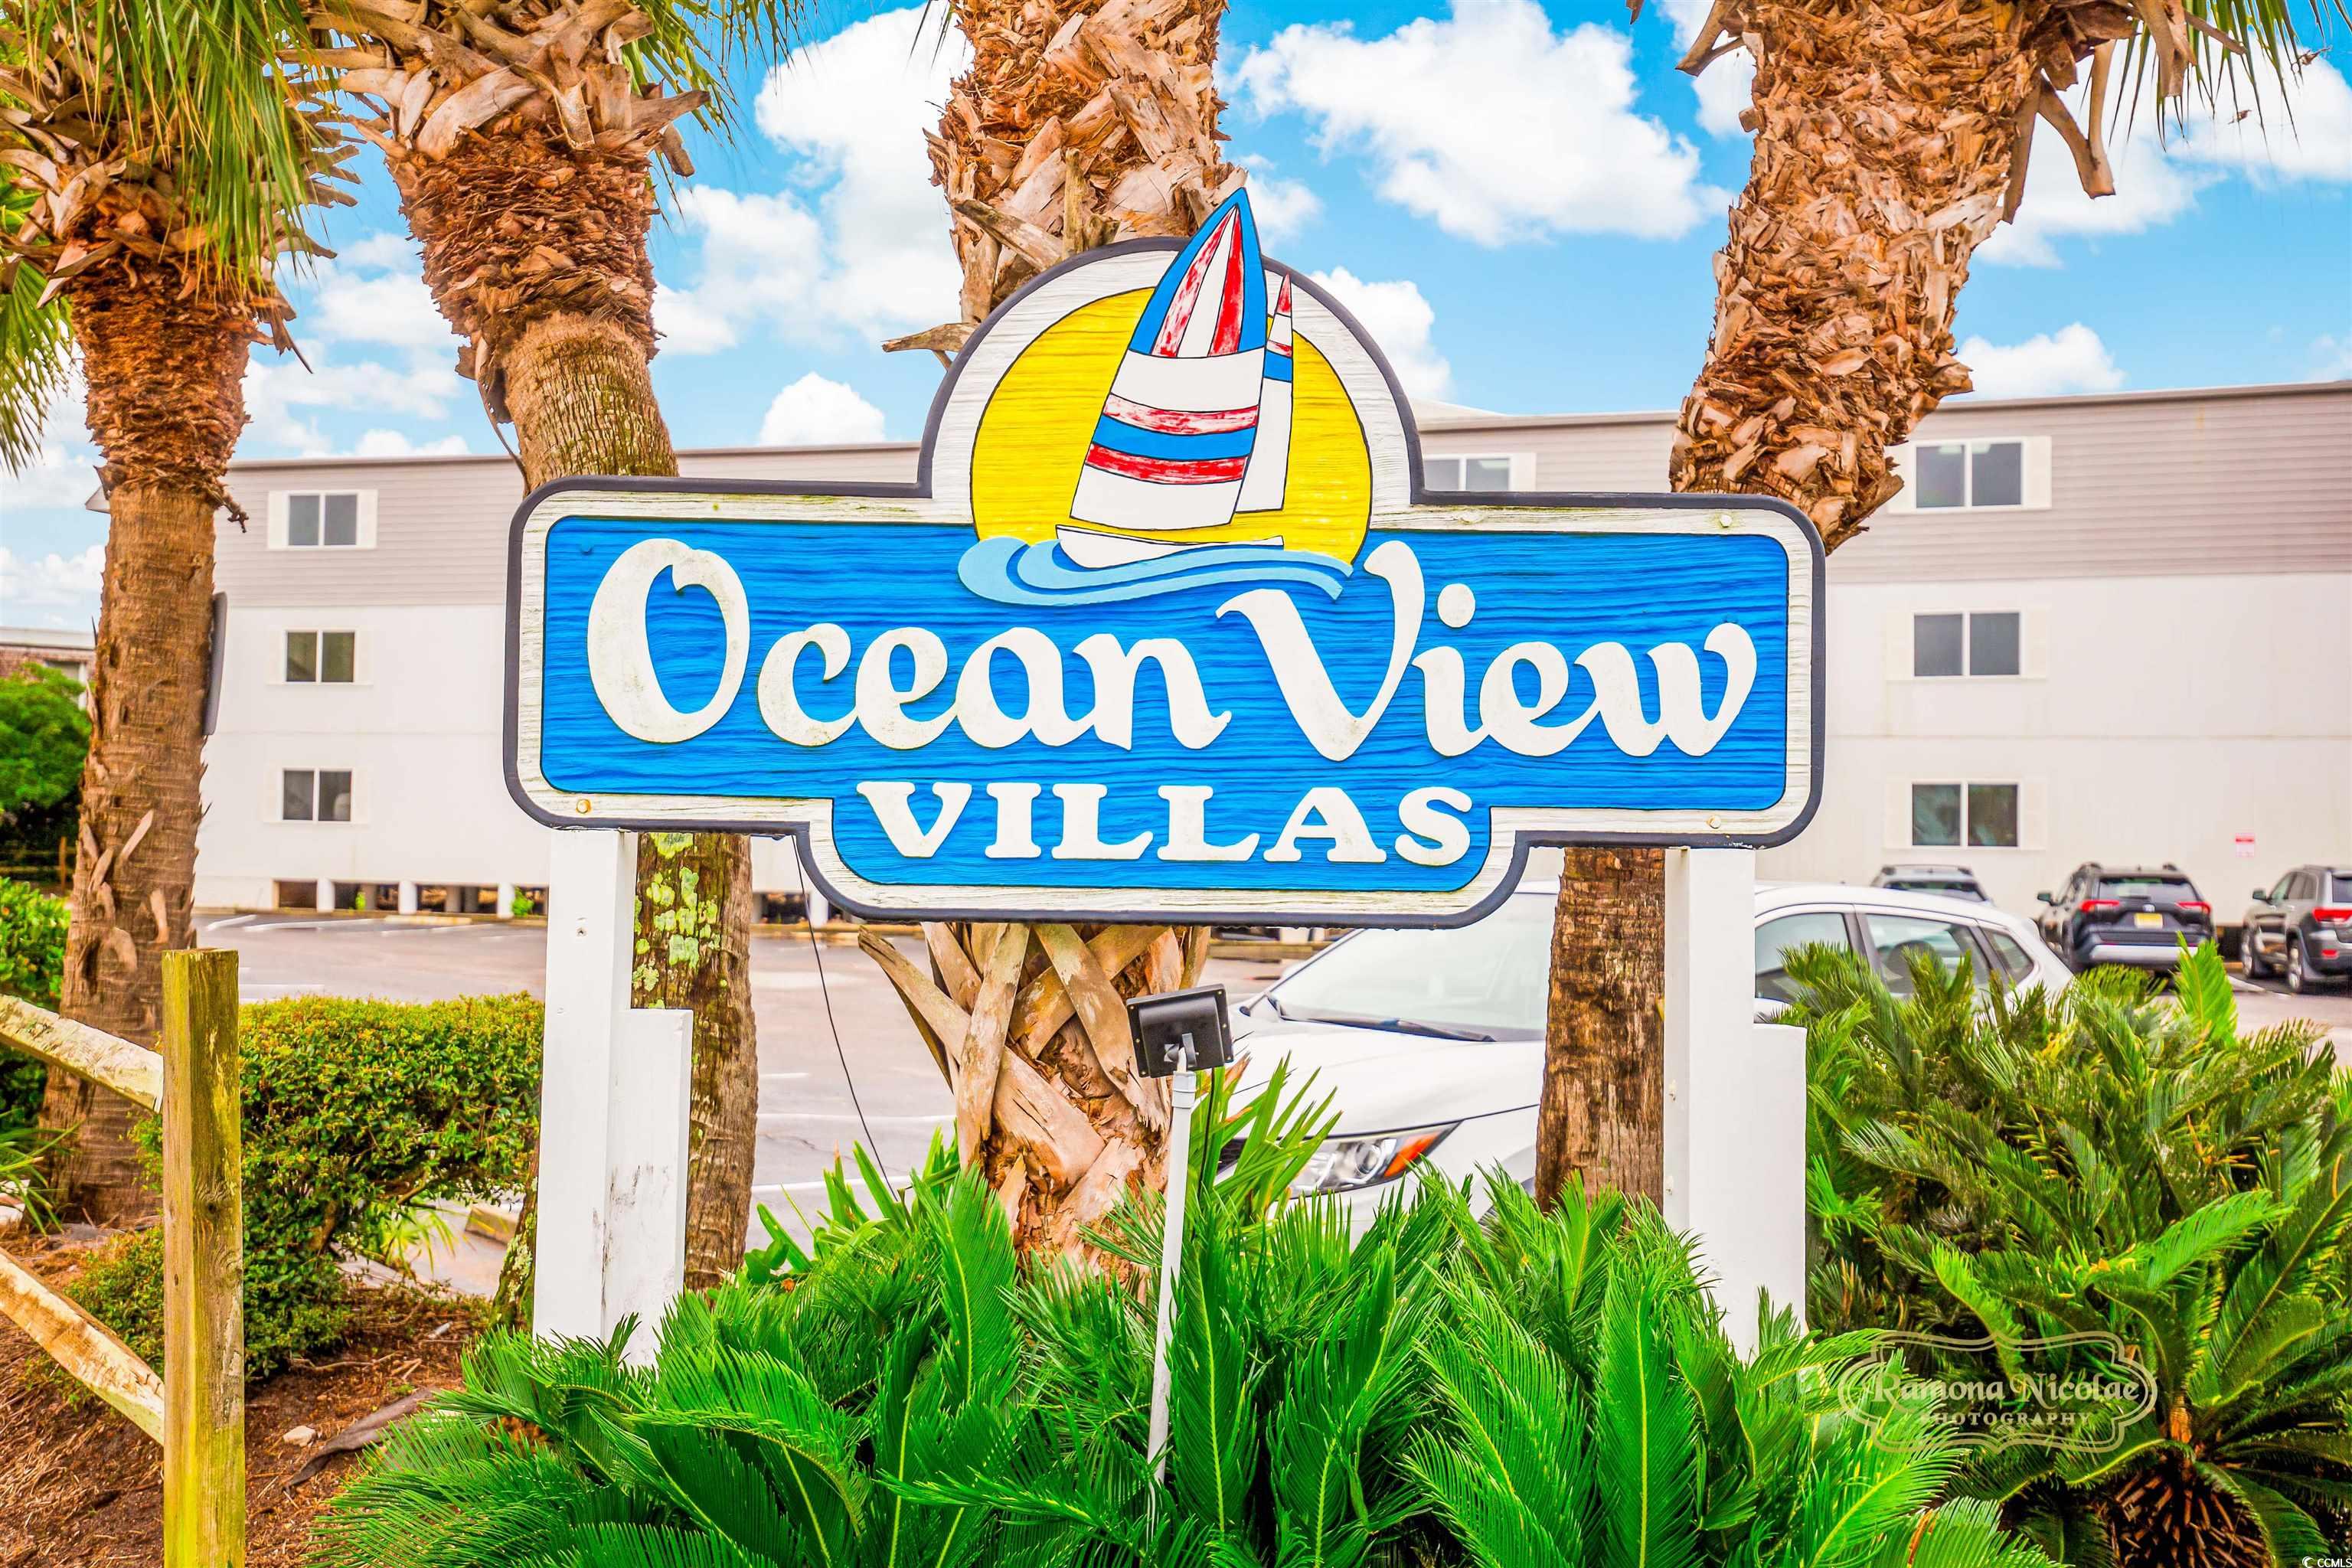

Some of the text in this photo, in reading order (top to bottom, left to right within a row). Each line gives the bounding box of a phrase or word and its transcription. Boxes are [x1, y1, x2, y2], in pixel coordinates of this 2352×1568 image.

[586, 537, 1758, 763] Ocean View
[856, 781, 1473, 866] VILLAS
